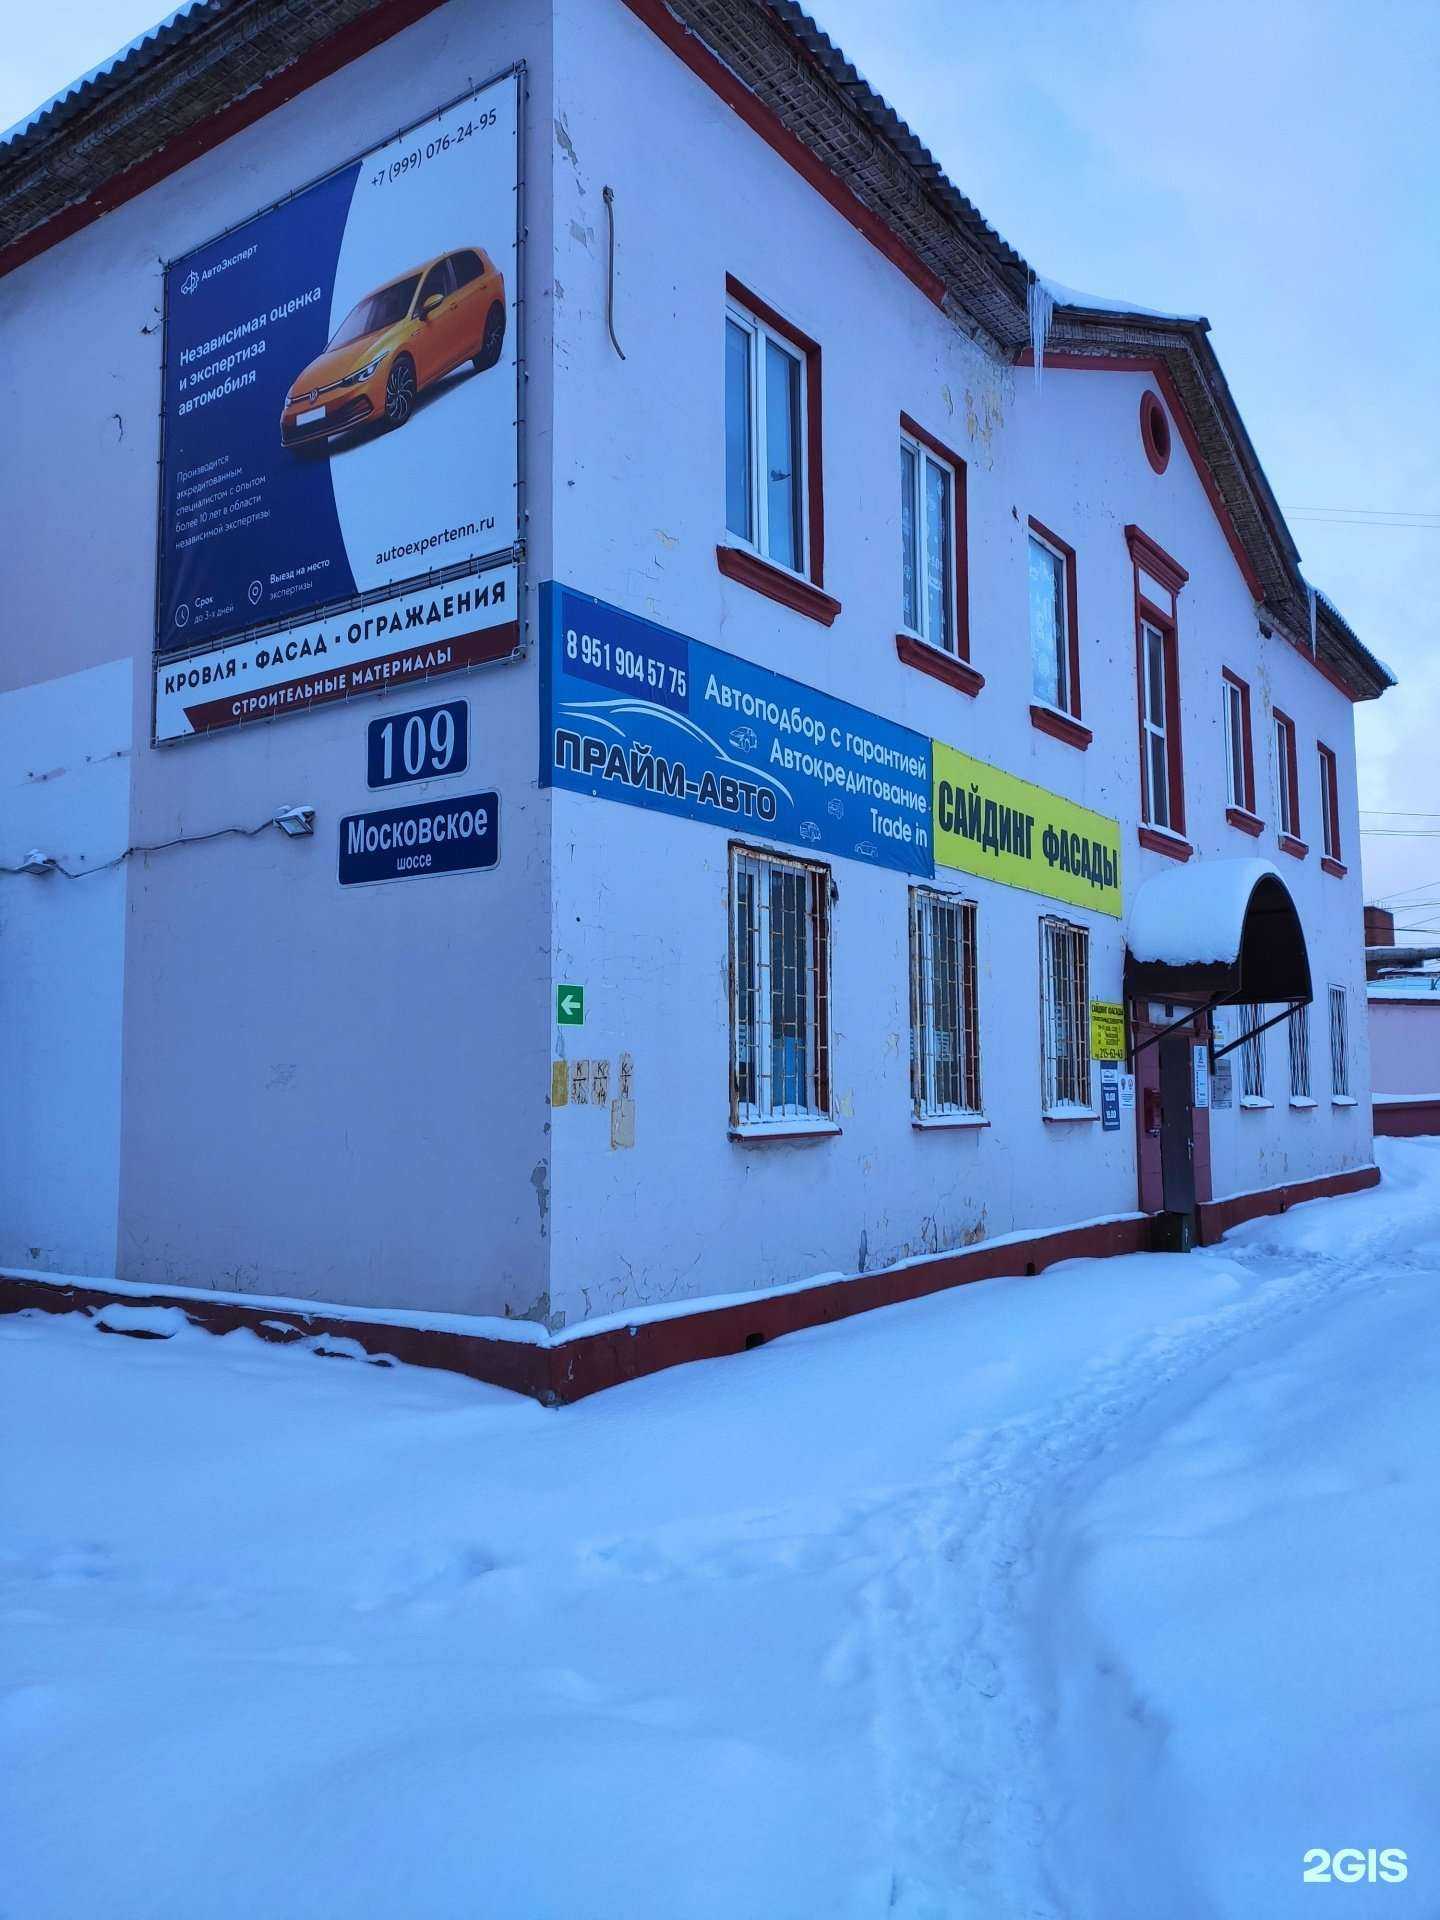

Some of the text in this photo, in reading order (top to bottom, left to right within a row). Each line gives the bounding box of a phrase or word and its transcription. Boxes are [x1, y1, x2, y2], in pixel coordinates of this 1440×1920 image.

[371, 108, 497, 186] +7 (999) 076-24-95
[201, 244, 258, 281] АвтоЭксперт
[180, 287, 321, 366] Независимая оценка
[179, 340, 266, 391] и экспертиза
[178, 370, 256, 416] автомобиля
[176, 455, 229, 483] Производится
[176, 467, 243, 499] аккредитованным
[175, 490, 228, 516] специалистом
[235, 475, 266, 493] опытом
[175, 517, 198, 532] более
[208, 508, 222, 521] лет
[229, 494, 262, 513] области
[175, 508, 271, 549] независимой экспертизы
[375, 516, 495, 565] autoexpertenn.ru
[269, 580, 313, 600] экспертизы
[270, 559, 330, 584] Выезд на место
[194, 596, 214, 608] Срок
[194, 614, 204, 624] до
[217, 604, 234, 618] дней
[164, 581, 506, 695] КРОВЛЯ ФАСАД ОГРАЖДЕНИЯ
[232, 648, 452, 716] СТРОИТЕЛЬНЫЕ МАТЕРИАЛЫ
[567, 629, 686, 697] 8 951 904 57 75
[380, 709, 455, 779] 109
[704, 673, 927, 780] Автоподбор с гарантией
[554, 727, 777, 822] ПРАЙМ-АВТО
[770, 739, 927, 813] Автокредитование
[348, 807, 488, 854] Московское
[870, 807, 928, 848] Trade in
[938, 780, 1118, 890] САЙДИНГ ФАСАДЫ
[396, 853, 432, 871] шоссе
